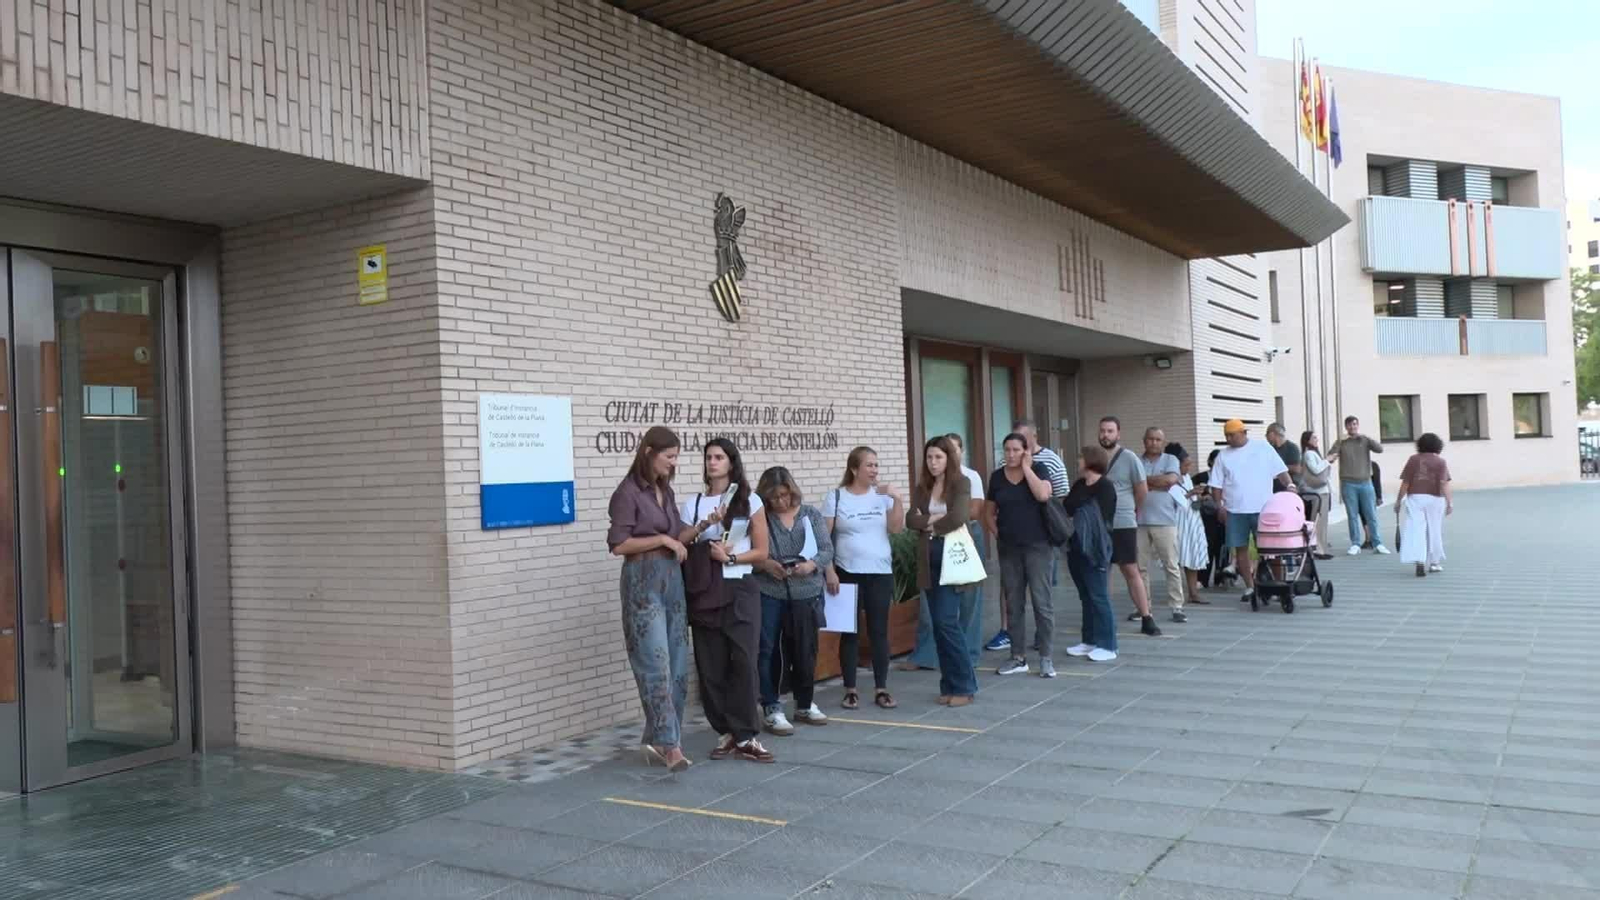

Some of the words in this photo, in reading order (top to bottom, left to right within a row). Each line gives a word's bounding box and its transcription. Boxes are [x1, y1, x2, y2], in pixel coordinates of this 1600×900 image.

[605, 401, 659, 423] CIUTAT
[663, 402, 682, 424] DE
[686, 403, 703, 424] LA
[708, 400, 759, 425] JUSTÍCIA
[763, 406, 779, 425] DE
[782, 402, 834, 426] CASTELLÓ
[596, 431, 643, 454] CIUDA
[683, 431, 702, 452] LA
[761, 432, 777, 451] DE
[778, 428, 838, 451] CASTELLÓN
